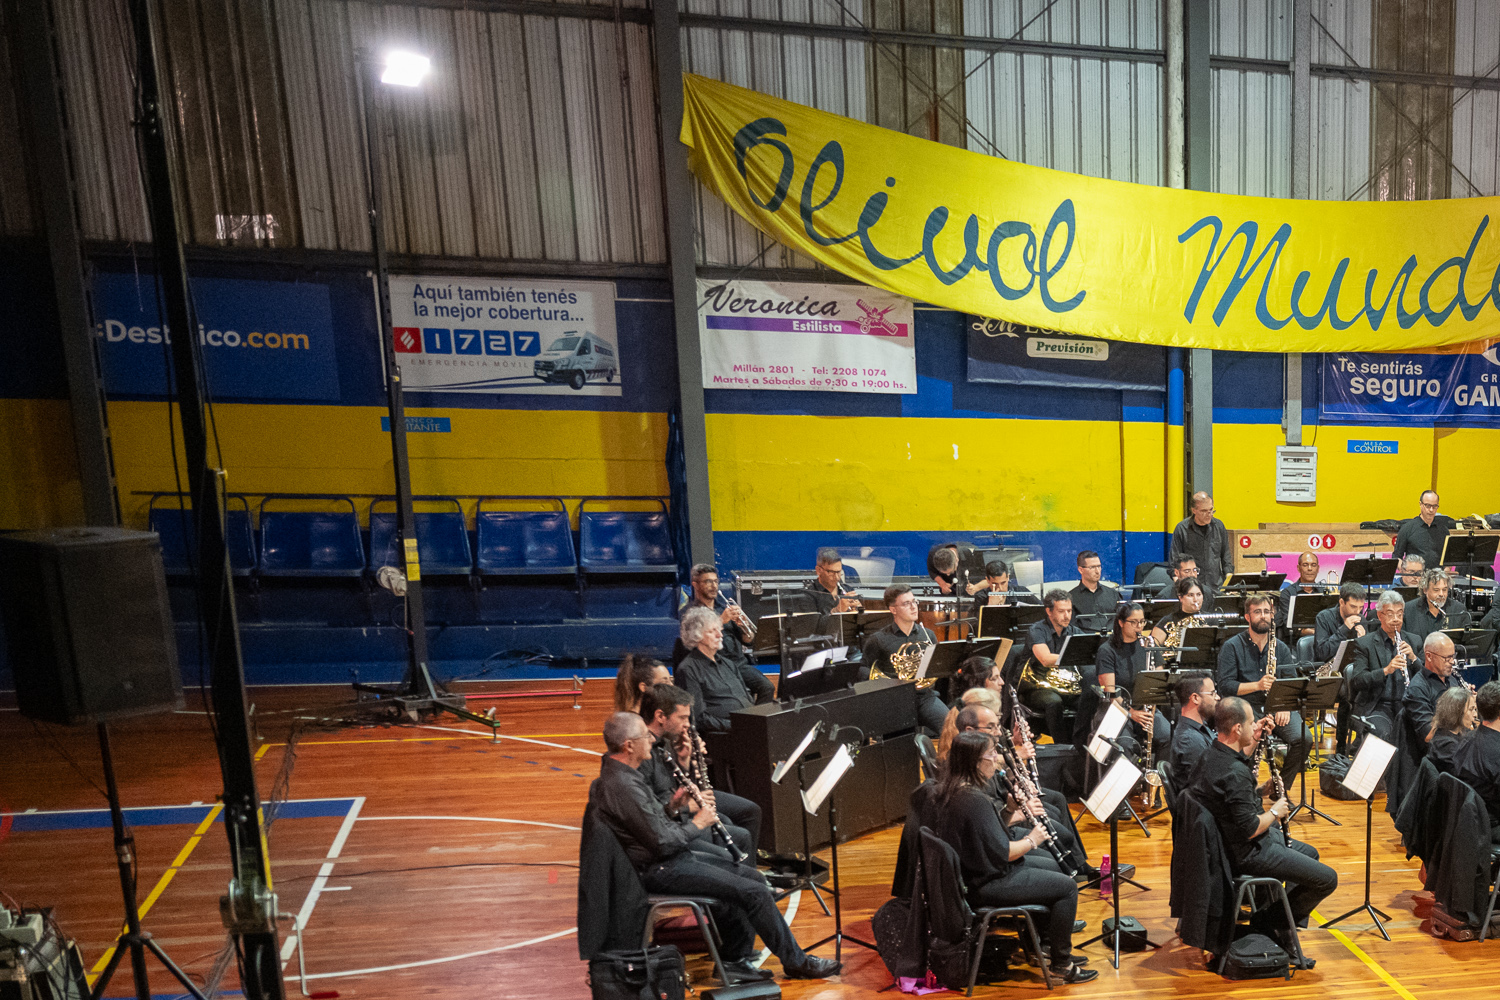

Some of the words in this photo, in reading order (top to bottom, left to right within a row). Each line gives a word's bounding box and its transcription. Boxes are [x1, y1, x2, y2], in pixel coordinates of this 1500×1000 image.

[734, 117, 1087, 313] Olivol
[413, 283, 452, 301] Aquí
[457, 286, 526, 303] también
[532, 288, 577, 304] tenés
[702, 284, 841, 317] Veronica
[414, 302, 429, 317] la
[434, 304, 483, 322] mejor
[488, 303, 584, 322] cobertura...
[792, 321, 842, 333] Estilista
[432, 331, 536, 354] 1727
[1036, 341, 1094, 354] Previsión
[410, 358, 488, 368] EMERGENCIA
[733, 364, 765, 374] Millán
[768, 366, 794, 374] 2801
[812, 367, 829, 375] Tel:
[832, 367, 858, 376] 2208
[862, 368, 887, 377] 1074
[1338, 358, 1356, 373] Te
[1360, 360, 1423, 375] sentirás
[713, 375, 749, 384] Martes
[762, 375, 806, 386] Sábados
[809, 376, 822, 386] de
[825, 378, 848, 387] 9:30
[862, 379, 890, 388] 19:00
[893, 380, 907, 389] hs.
[1350, 376, 1441, 402] seguro
[1354, 445, 1392, 453] CONTROL
